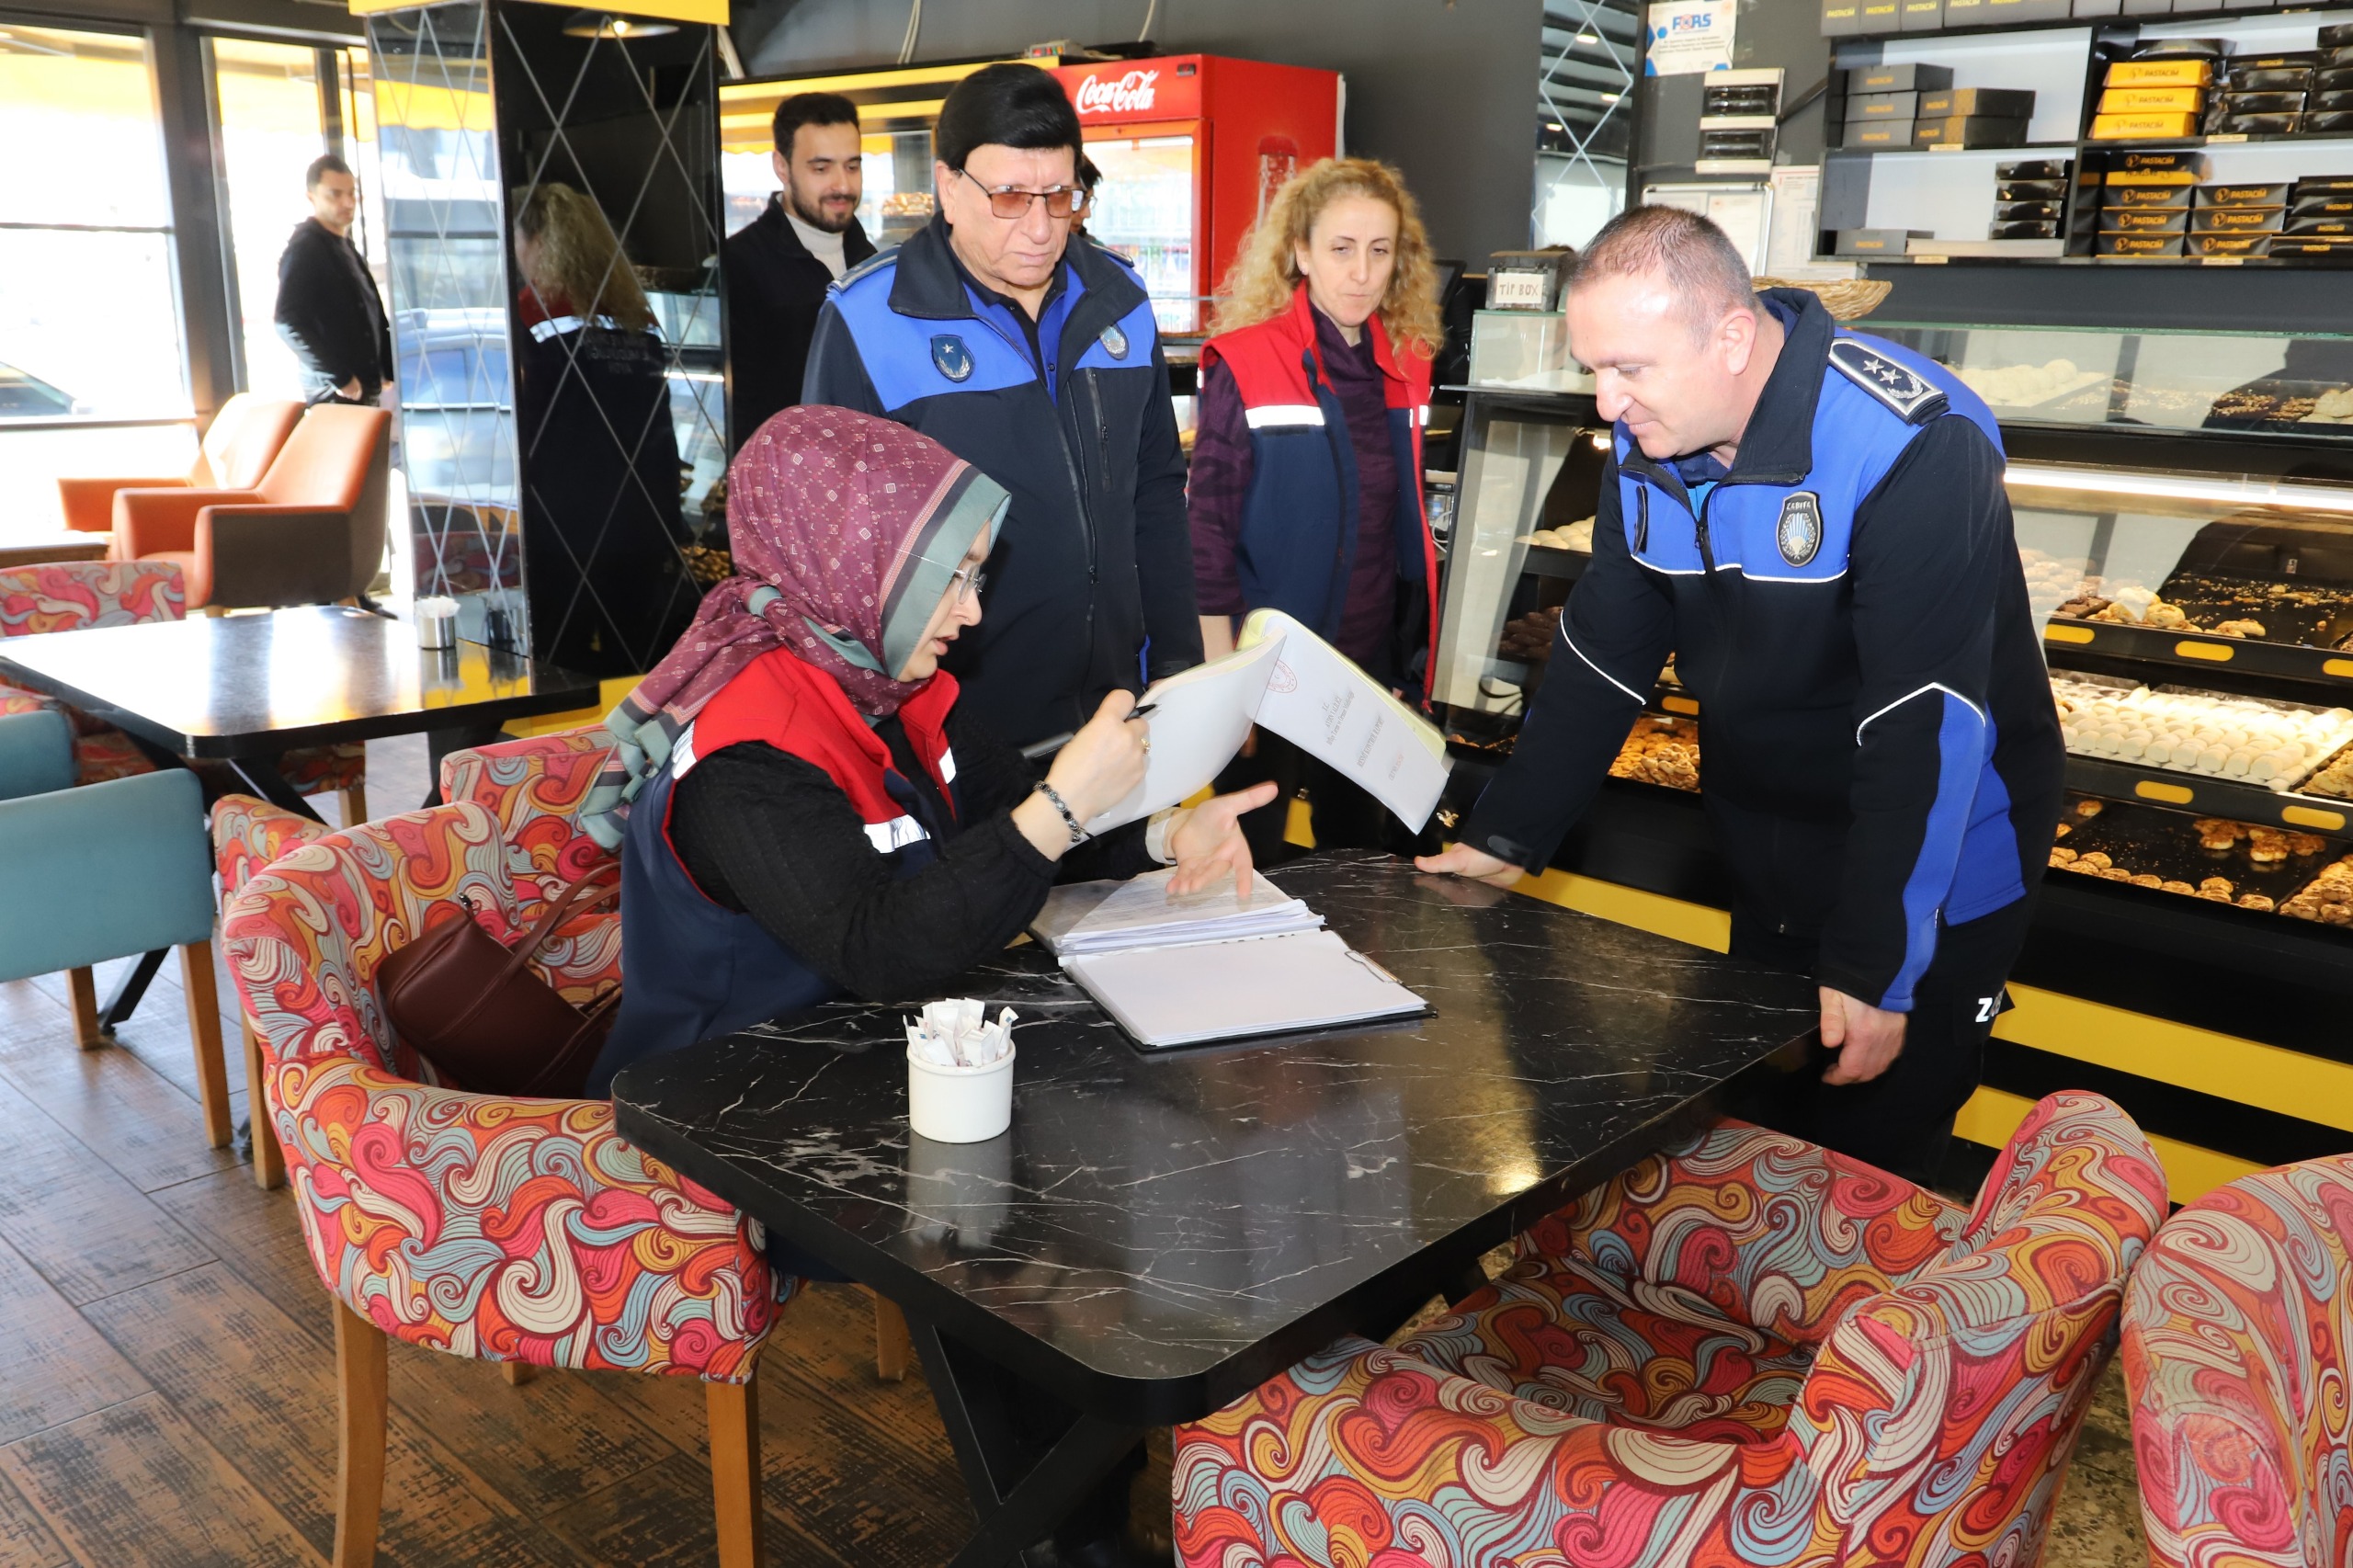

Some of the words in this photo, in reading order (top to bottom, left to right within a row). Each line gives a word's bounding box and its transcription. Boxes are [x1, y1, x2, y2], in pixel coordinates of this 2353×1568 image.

[1672, 13, 1711, 29] FORS
[1076, 70, 1160, 114] Coca-Cola
[1518, 283, 1539, 296] BOX
